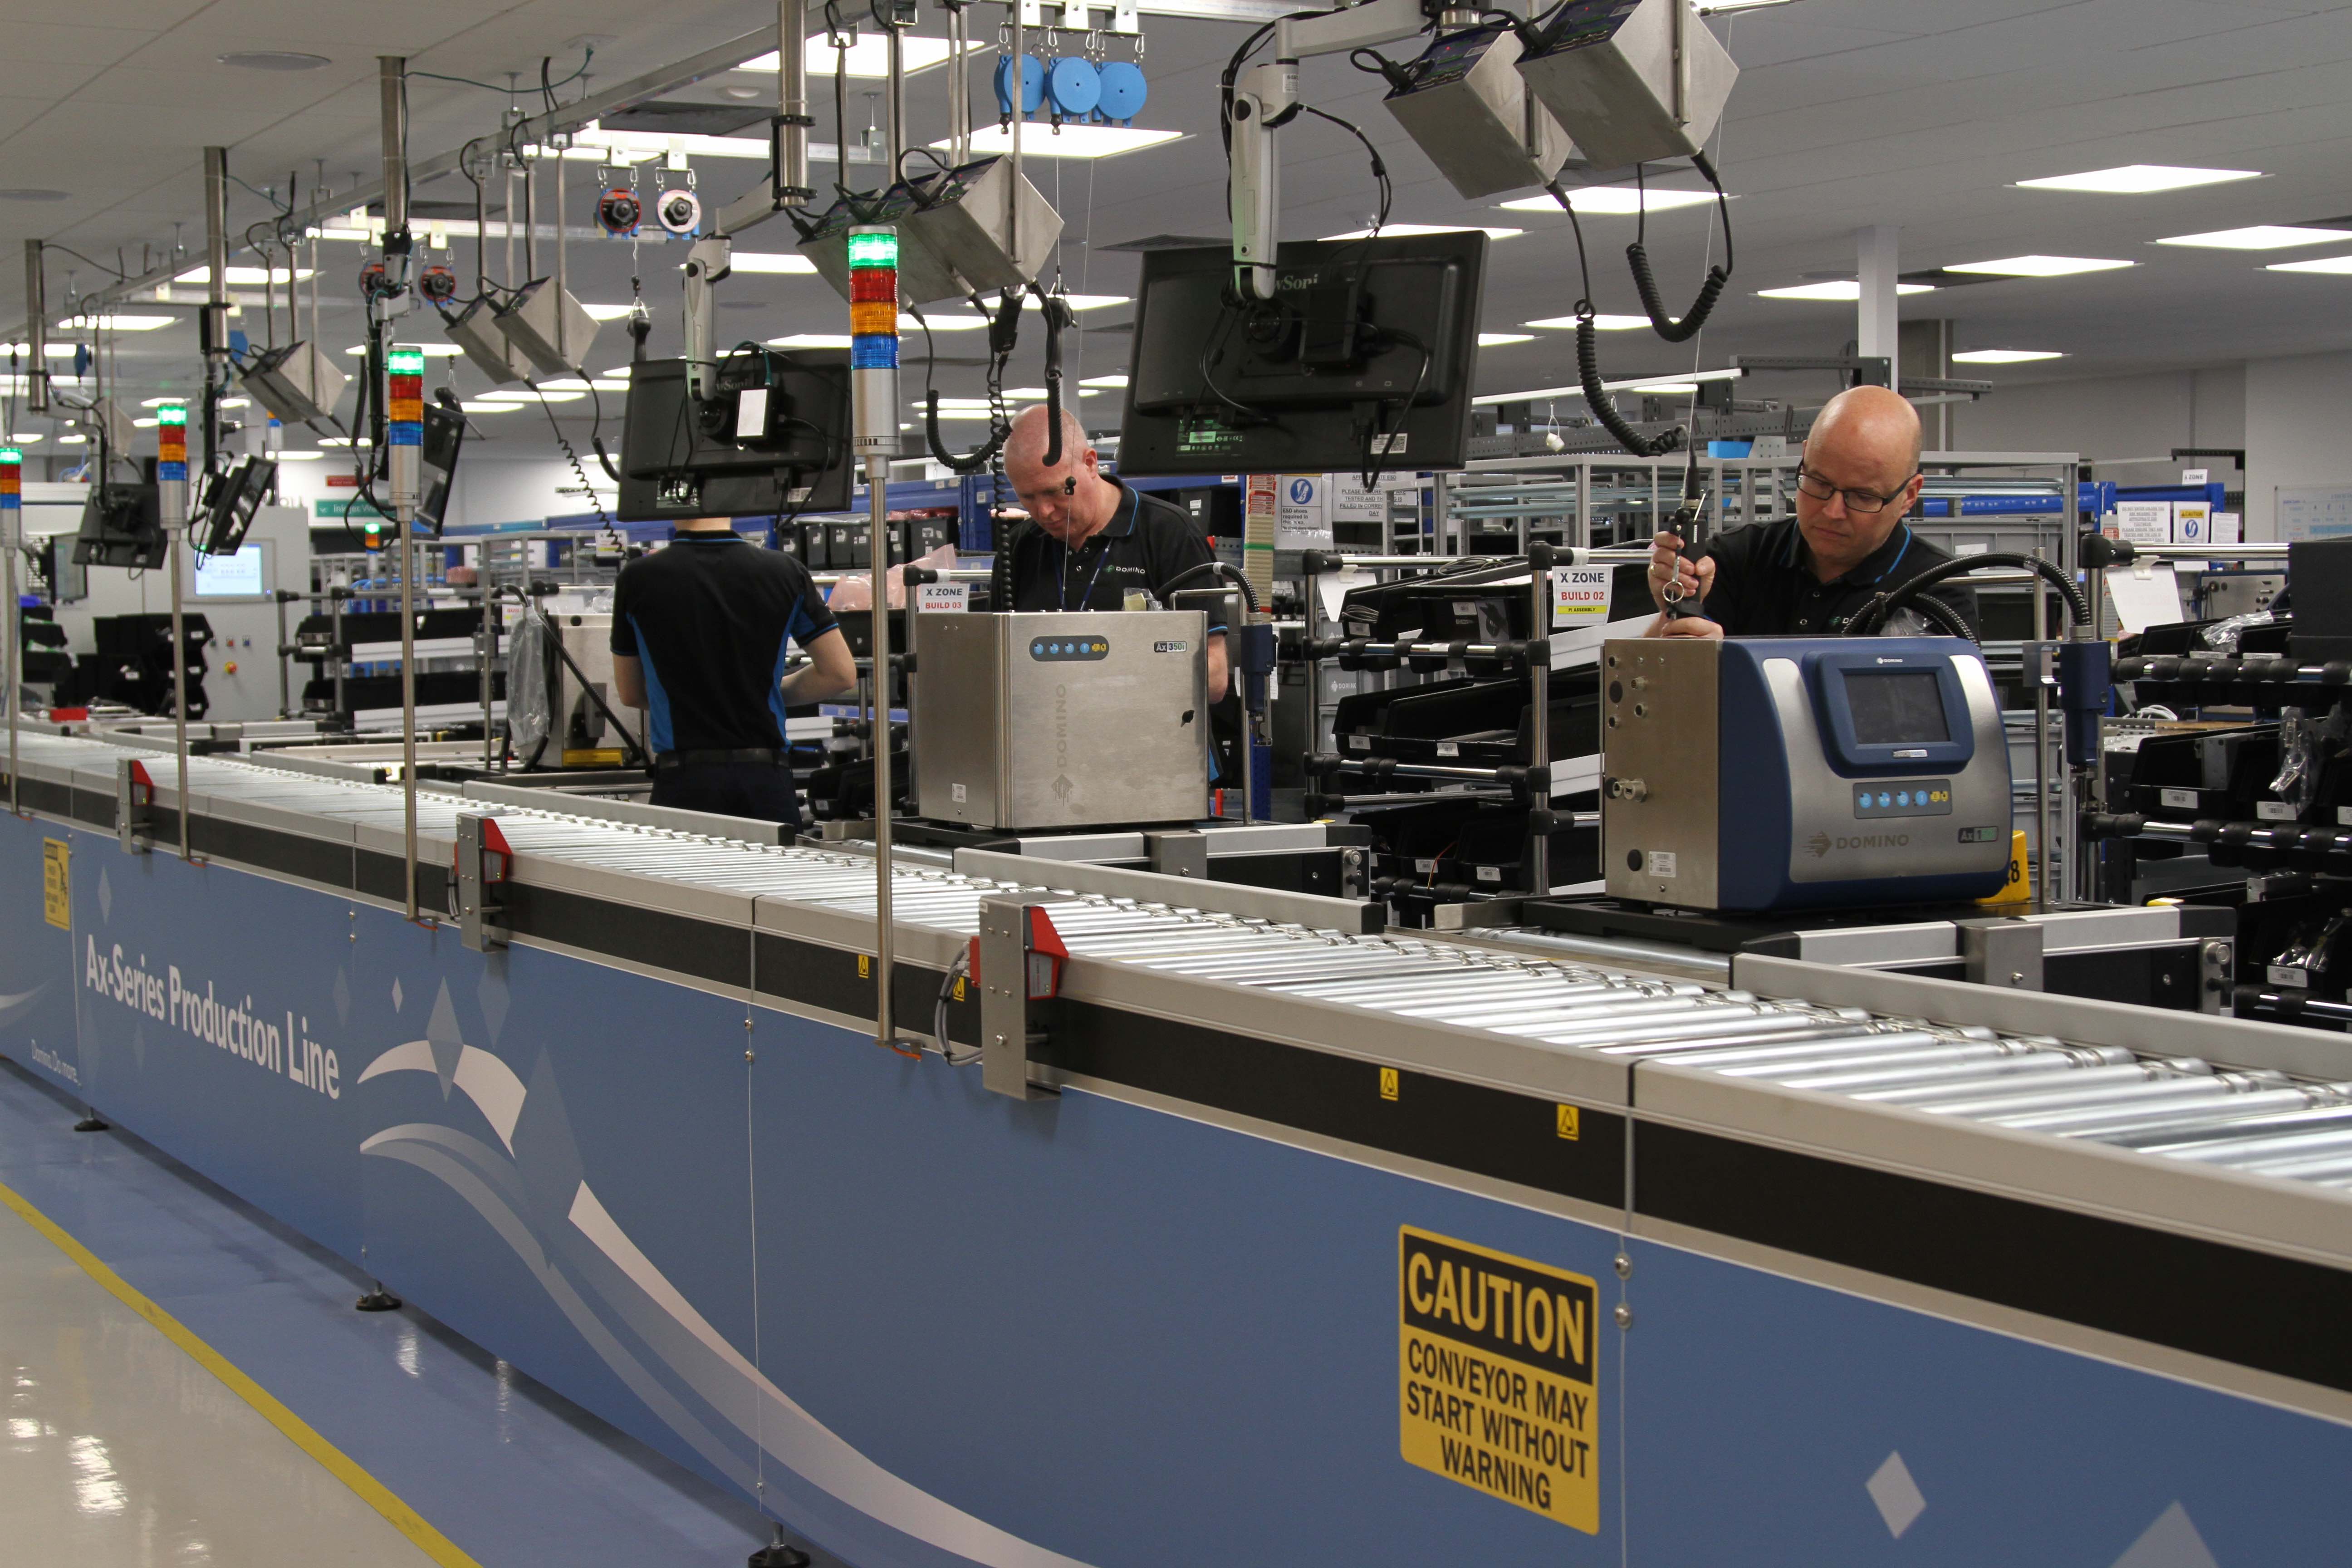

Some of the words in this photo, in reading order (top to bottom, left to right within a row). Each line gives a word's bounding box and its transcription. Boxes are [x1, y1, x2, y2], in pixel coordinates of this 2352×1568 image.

[1560, 573, 1568, 583] X
[1572, 573, 1605, 583] ZONE
[1561, 592, 1590, 600] BUILD
[1593, 592, 1604, 600] 02
[1056, 684, 1066, 768] DOMINO
[1836, 834, 1909, 850] DOMINO
[86, 934, 165, 1021] Ax-Series
[169, 965, 281, 1074] Production
[287, 1010, 339, 1099] Line
[1408, 1252, 1584, 1366] CAUTION
[1408, 1338, 1528, 1413] CONVEYOR
[1536, 1381, 1588, 1432] MAY
[1407, 1381, 1475, 1437] START
[1481, 1405, 1590, 1479] WITHOUT
[1441, 1435, 1552, 1511] WARNING
